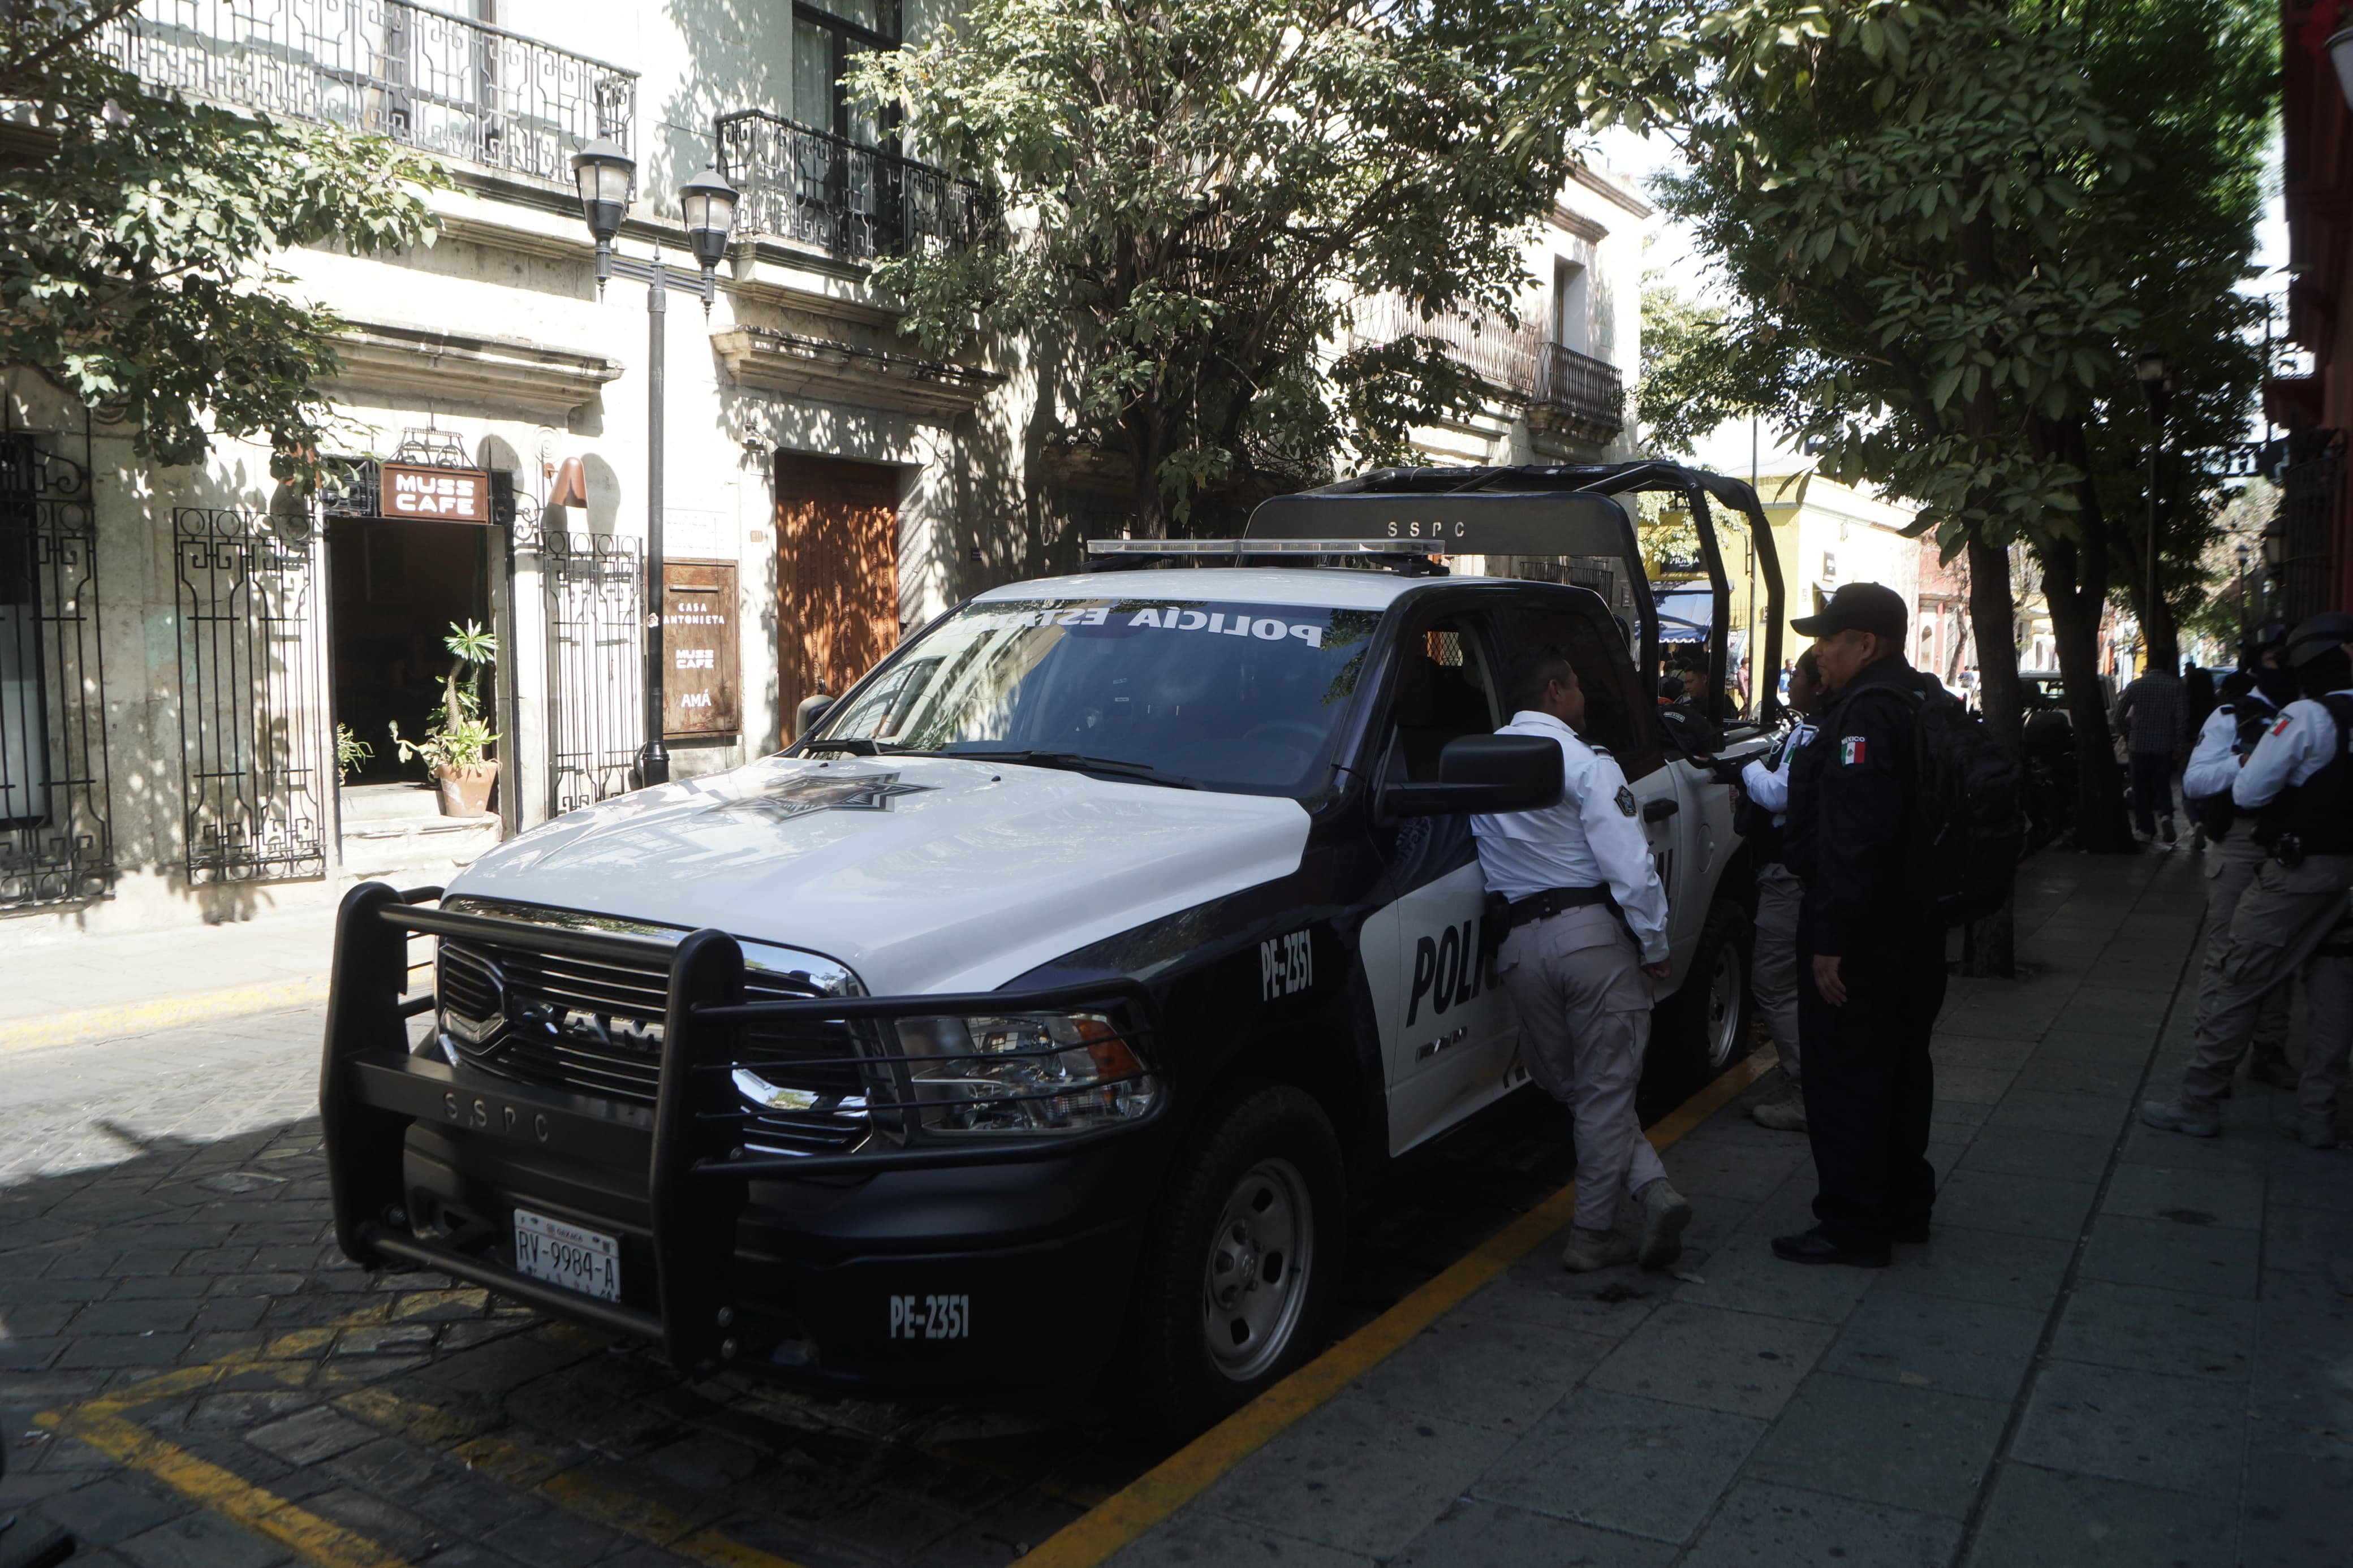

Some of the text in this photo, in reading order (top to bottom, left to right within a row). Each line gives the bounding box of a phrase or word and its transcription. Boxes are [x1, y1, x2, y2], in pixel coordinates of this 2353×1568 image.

[396, 474, 474, 496] MUSS
[396, 494, 474, 515] CAFE
[678, 603, 707, 612] CASA
[663, 615, 724, 624] ANTONIETA
[676, 650, 713, 659] MUSS
[676, 659, 713, 668] CAFE
[681, 689, 712, 707] AMÁ
[1260, 928, 1312, 1002] PE-2351
[512, 995, 666, 1053] RAM
[519, 1231, 614, 1289] RV-9984-A
[890, 1294, 969, 1340] PE-2351
